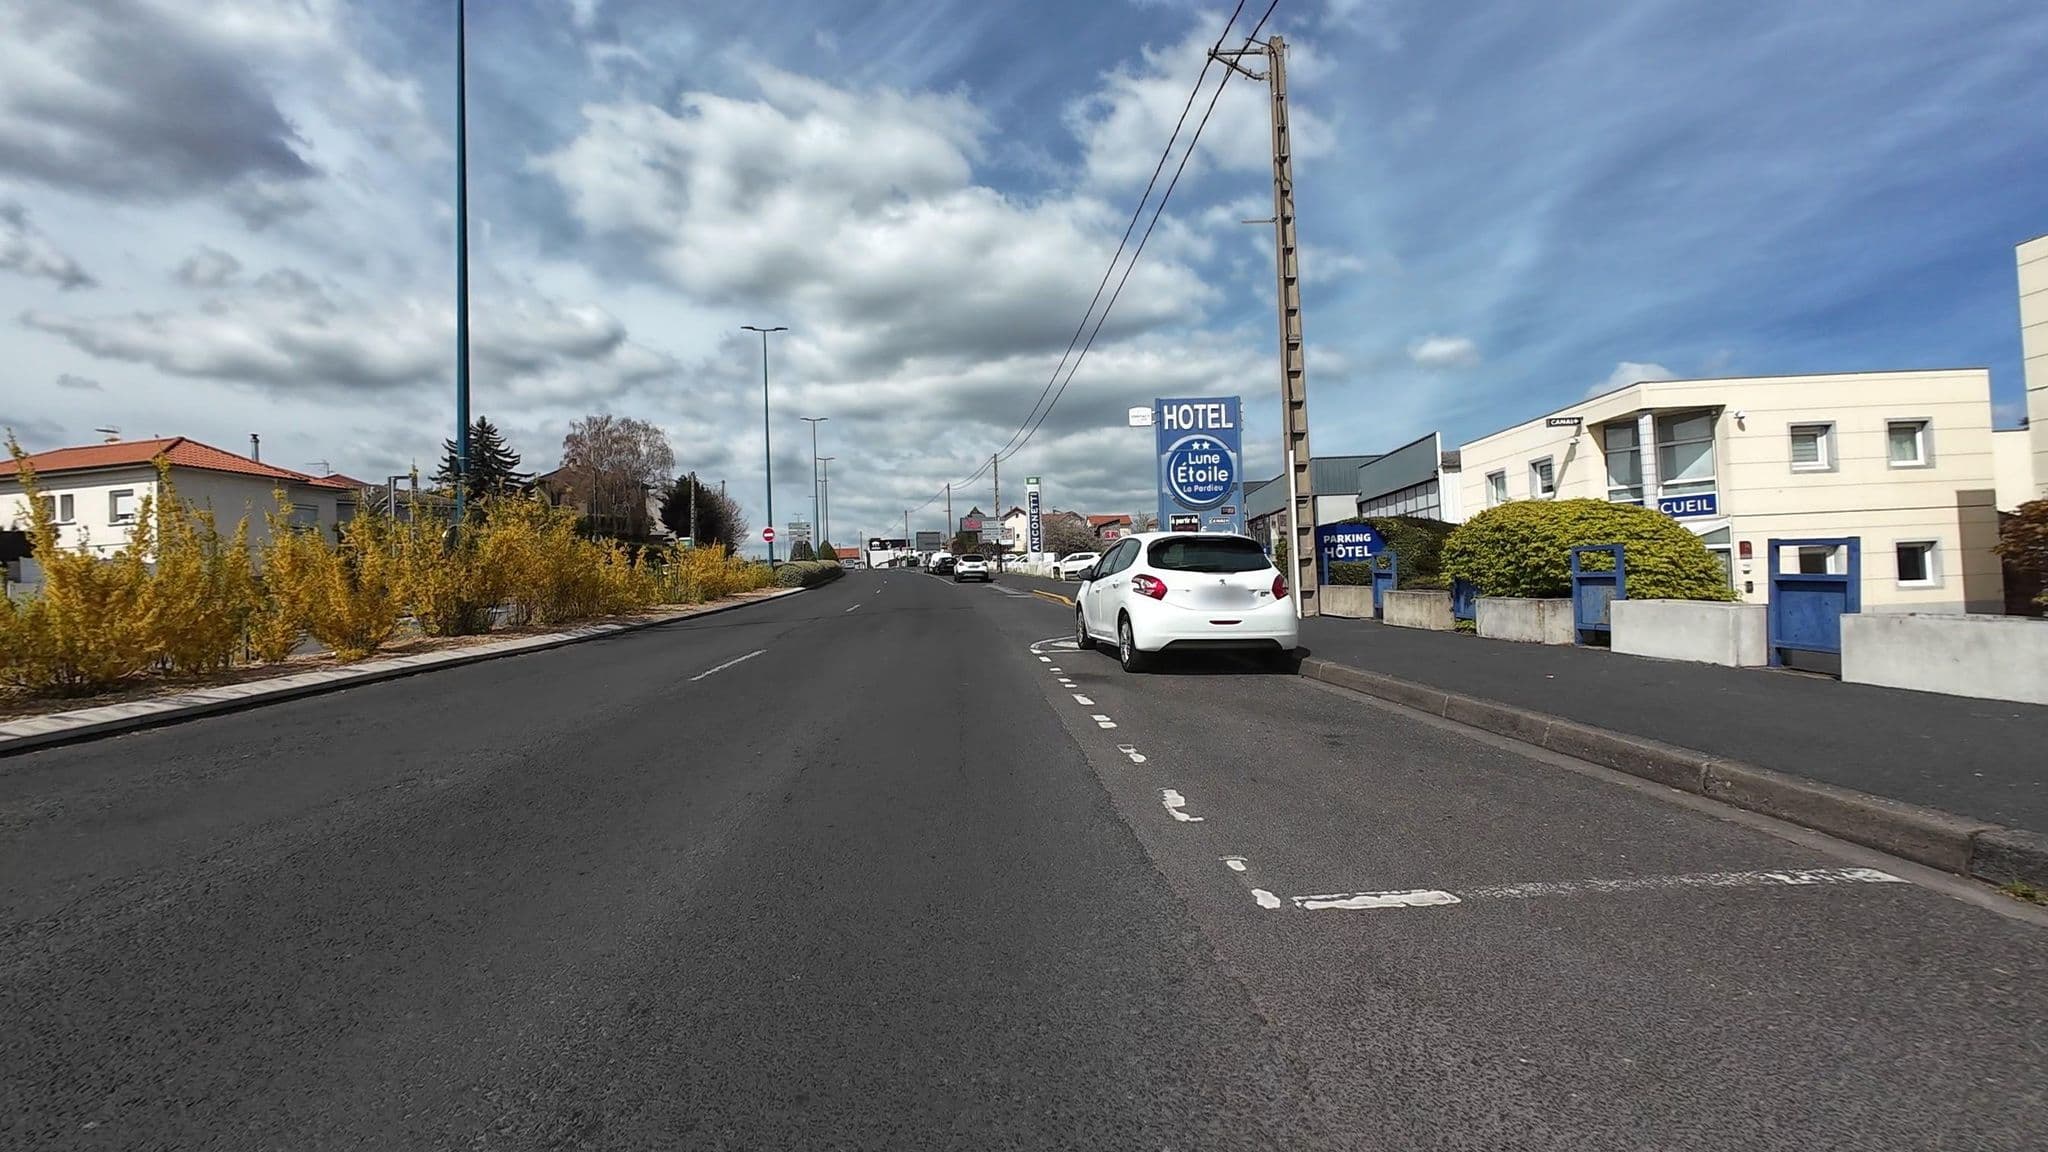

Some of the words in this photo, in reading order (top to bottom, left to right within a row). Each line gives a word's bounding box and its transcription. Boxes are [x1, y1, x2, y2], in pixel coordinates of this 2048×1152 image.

[1163, 403, 1234, 430] HOTEL
[1188, 452, 1220, 464] Lune
[1177, 462, 1229, 483] Étoile
[1194, 483, 1224, 492] Pardieu
[1030, 492, 1040, 551] ANCONETTI
[1323, 533, 1372, 544] PARKING
[1324, 543, 1373, 558] HÔTEL
